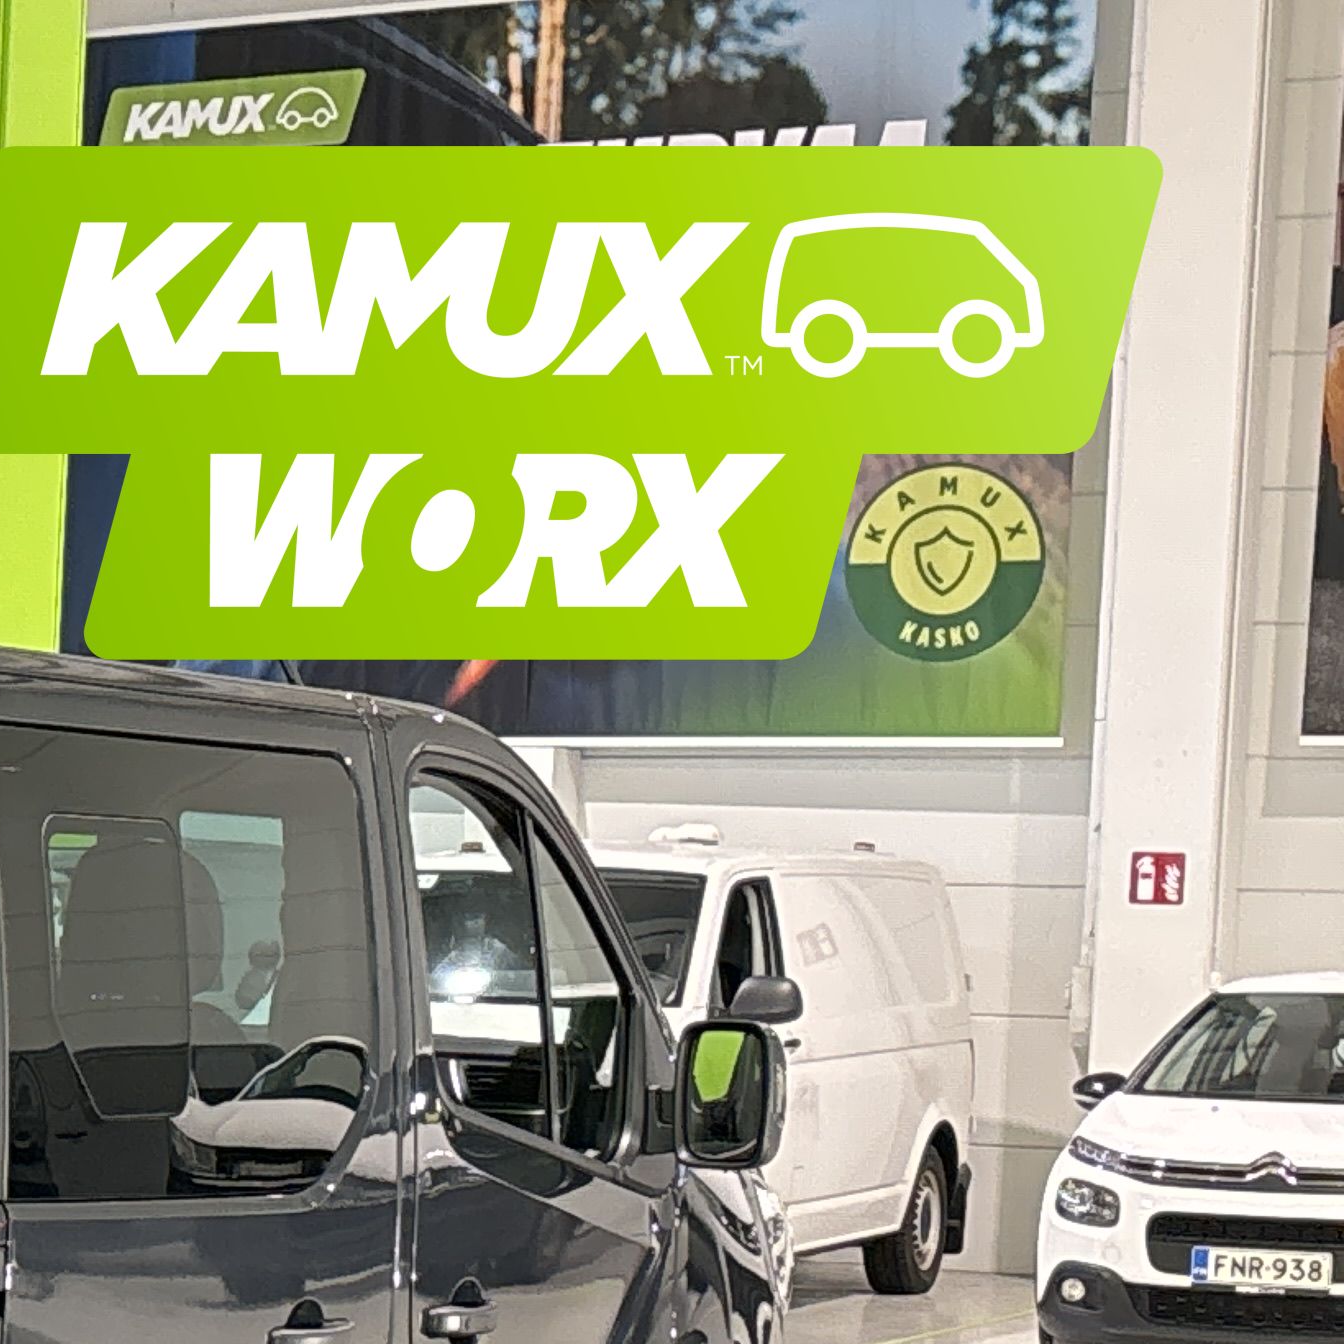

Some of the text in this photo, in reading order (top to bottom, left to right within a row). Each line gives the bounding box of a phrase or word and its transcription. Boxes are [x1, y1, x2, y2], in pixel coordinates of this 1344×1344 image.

[123, 92, 275, 143] KAMUX
[864, 476, 1028, 544] KAMUX
[899, 620, 981, 649] KASKO
